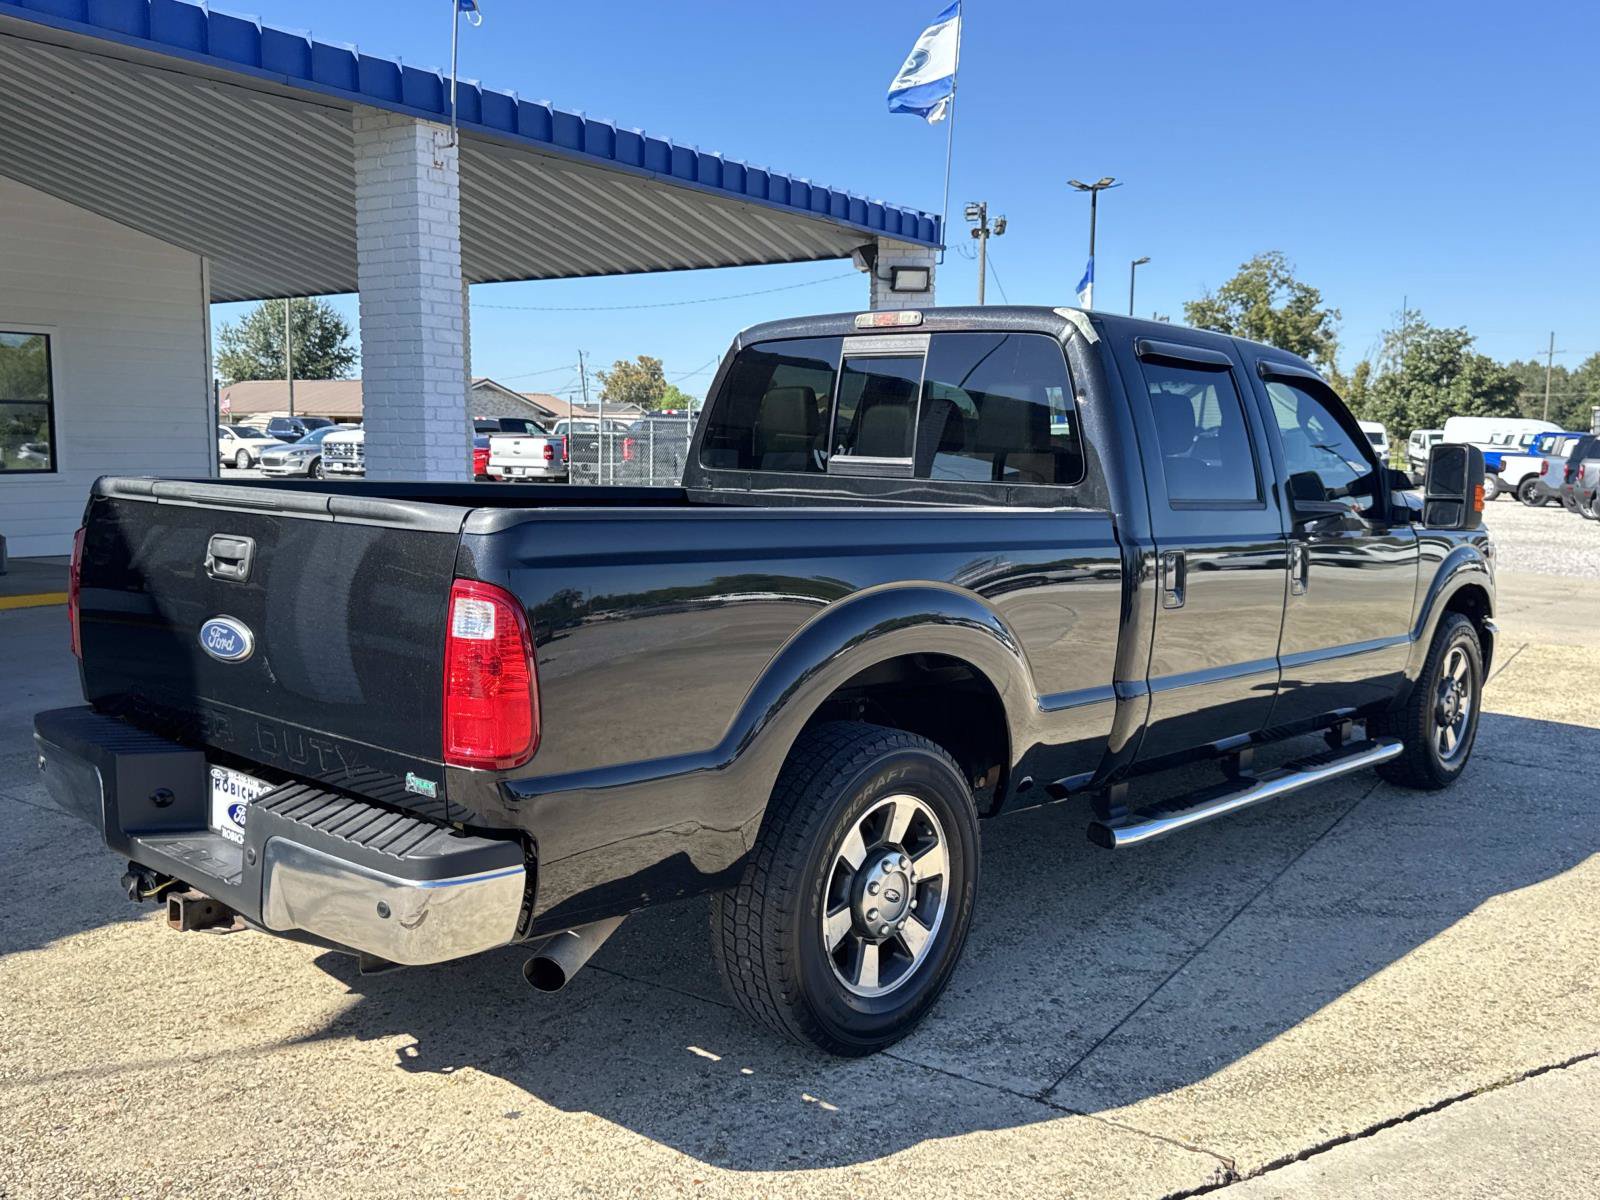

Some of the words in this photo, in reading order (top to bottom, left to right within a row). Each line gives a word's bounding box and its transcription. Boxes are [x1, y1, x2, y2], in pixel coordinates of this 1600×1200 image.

[208, 625, 235, 651] Ford
[256, 721, 359, 779] DUTY
[214, 777, 256, 801] ROBICH
